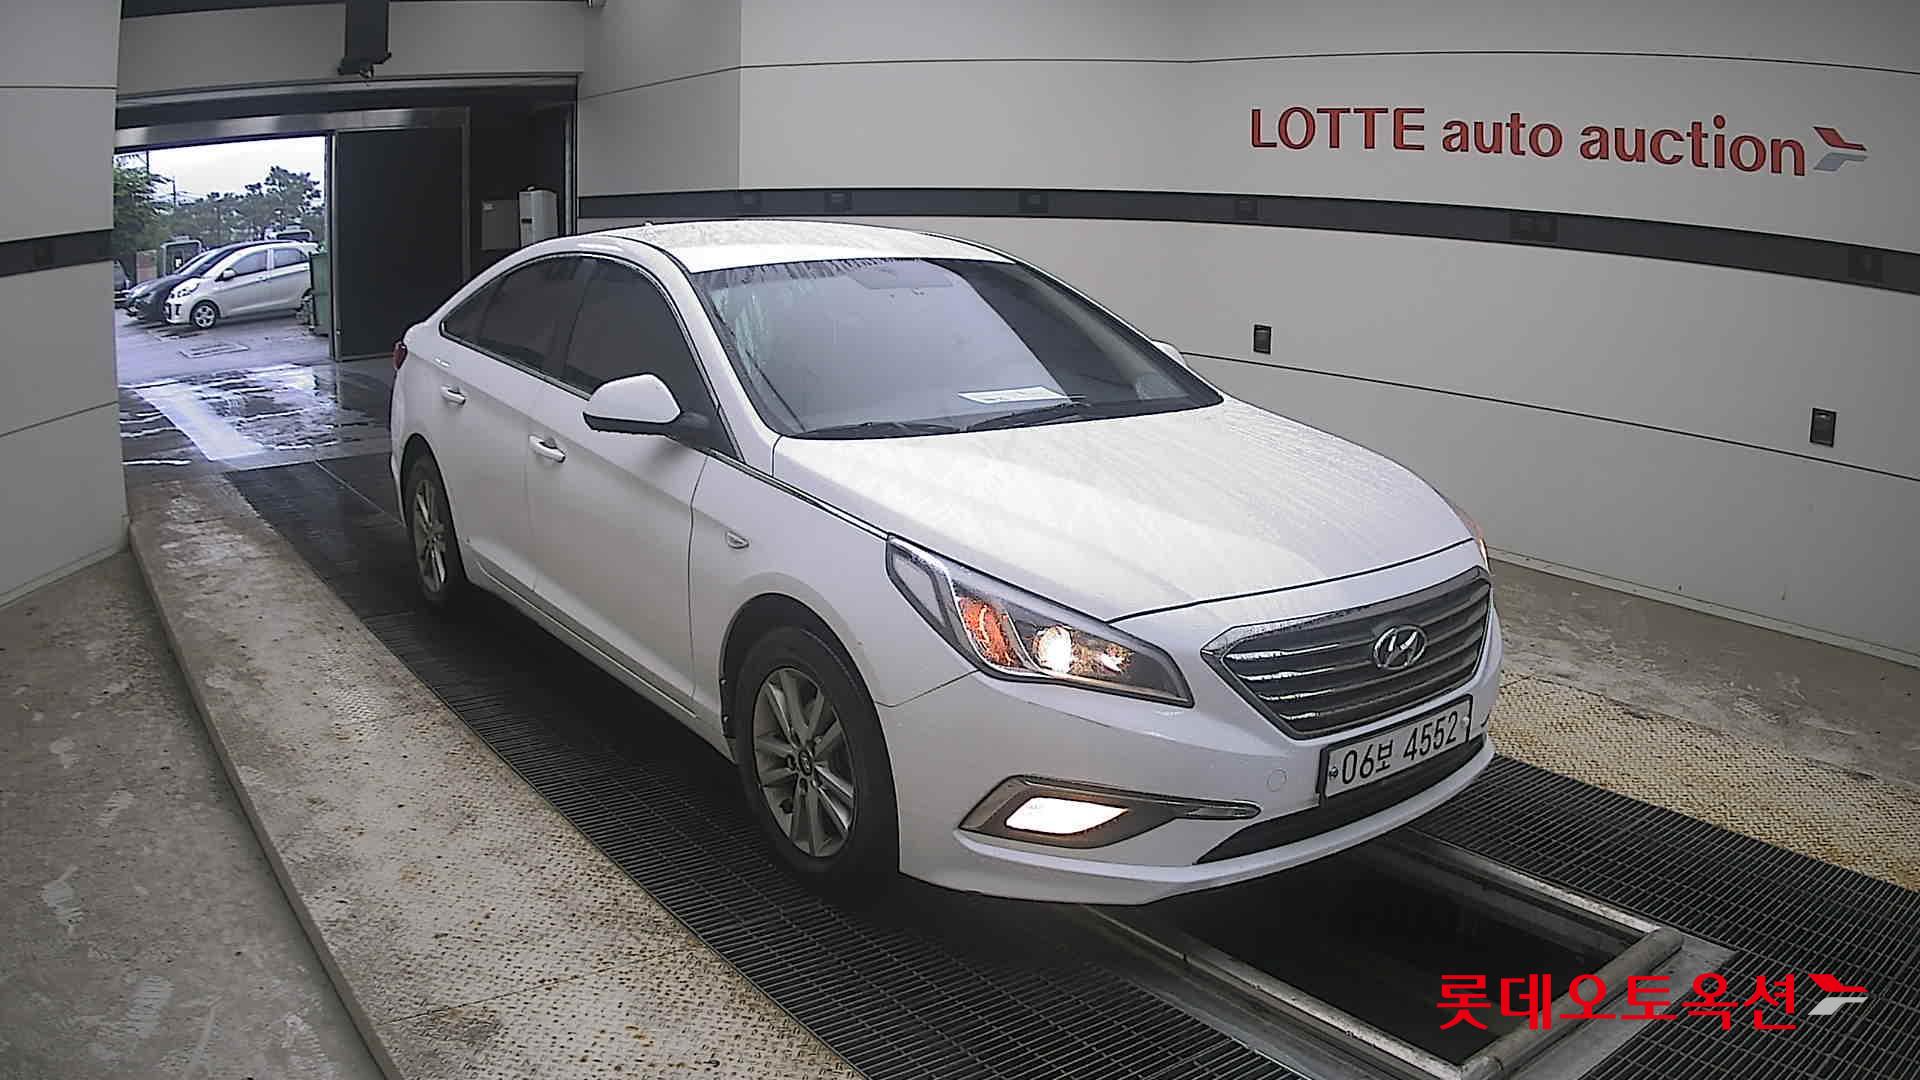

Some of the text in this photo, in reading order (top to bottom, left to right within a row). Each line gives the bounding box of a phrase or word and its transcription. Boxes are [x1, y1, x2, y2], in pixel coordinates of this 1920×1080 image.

[1250, 106, 1807, 177] LOTTE auto auction
[1342, 710, 1458, 785] 06보 4552
